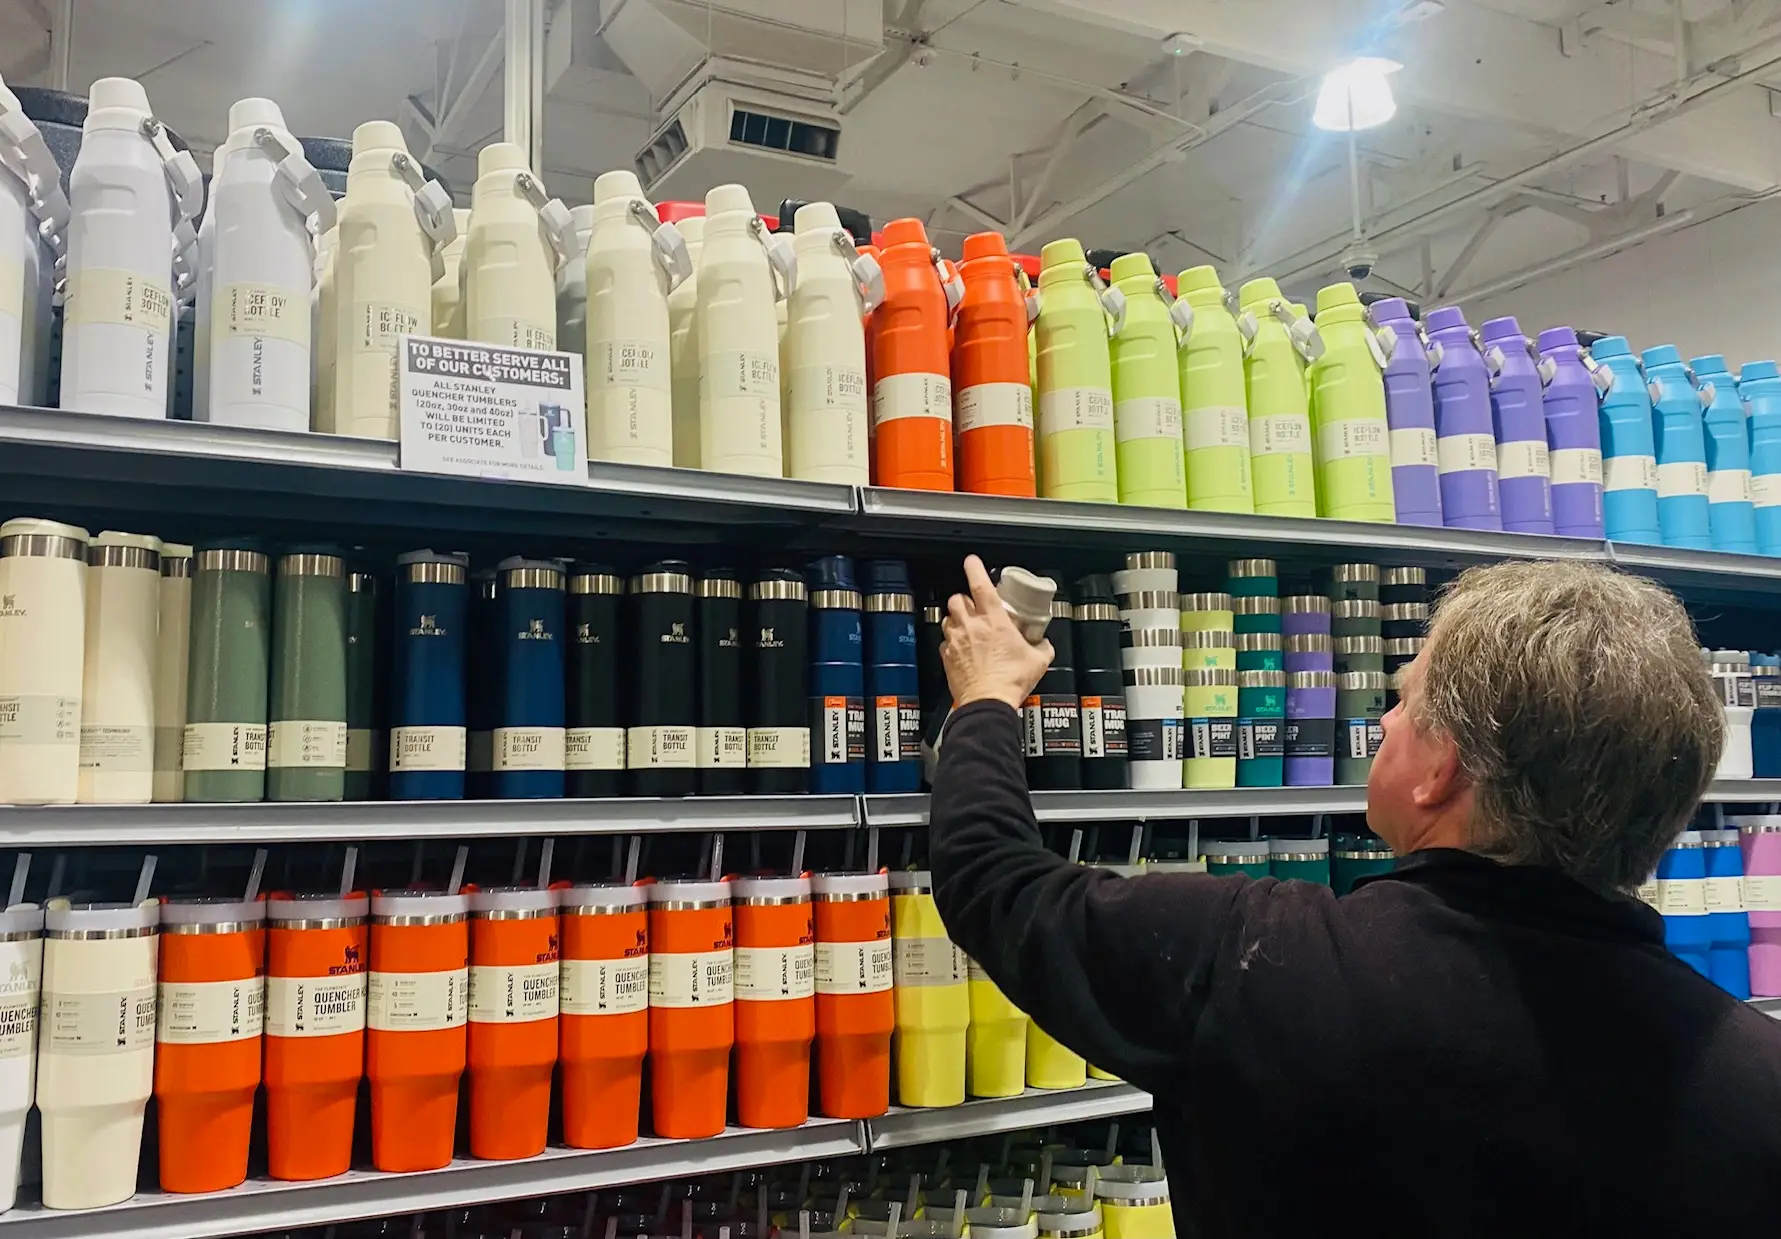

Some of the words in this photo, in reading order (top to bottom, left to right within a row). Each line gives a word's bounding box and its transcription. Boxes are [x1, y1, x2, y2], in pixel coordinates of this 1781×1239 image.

[146, 331, 154, 382] STANLEY
[252, 336, 262, 385] STANLEY
[410, 342, 431, 356] TO
[432, 344, 491, 364] BETTER
[492, 353, 539, 368] SERVE
[541, 358, 569, 372] ALL
[416, 358, 436, 371] OF
[438, 360, 470, 374] OUR
[472, 364, 564, 385] CUSTOMERS:
[434, 380, 452, 390] ALL
[454, 383, 496, 395] STANLEY
[412, 389, 464, 402] QUENCHER
[466, 394, 517, 407] TUMBLERS
[446, 403, 468, 413] 30oz
[470, 405, 487, 415] and
[426, 411, 450, 422] WILL
[452, 414, 465, 423] BE
[467, 416, 505, 427] LIMITED
[420, 422, 432, 430] TO
[435, 422, 453, 432] (20)
[456, 426, 484, 435] UNITS
[486, 428, 511, 438] EACH
[428, 433, 448, 442] PER
[450, 435, 504, 448] CUSTOMER.
[1043, 708, 1078, 718] TRAVEL
[1044, 718, 1070, 728] MUG
[1104, 720, 1124, 730] MUG
[405, 736, 435, 744] TRANSIT
[513, 736, 542, 744] TRANSIT
[566, 736, 591, 744] TRANSIT
[663, 734, 688, 742] TRANSIT
[754, 735, 779, 743] TRANSIT
[1211, 732, 1231, 740] PINT
[404, 744, 431, 752] BOTTLE
[512, 744, 538, 752] BOTTLE
[663, 742, 686, 750] BOTTLE
[754, 743, 776, 751] BOTTLE
[314, 988, 360, 1003] QUENCHER
[314, 1001, 356, 1015] TUMBLER
[119, 997, 127, 1035] STANLEY
